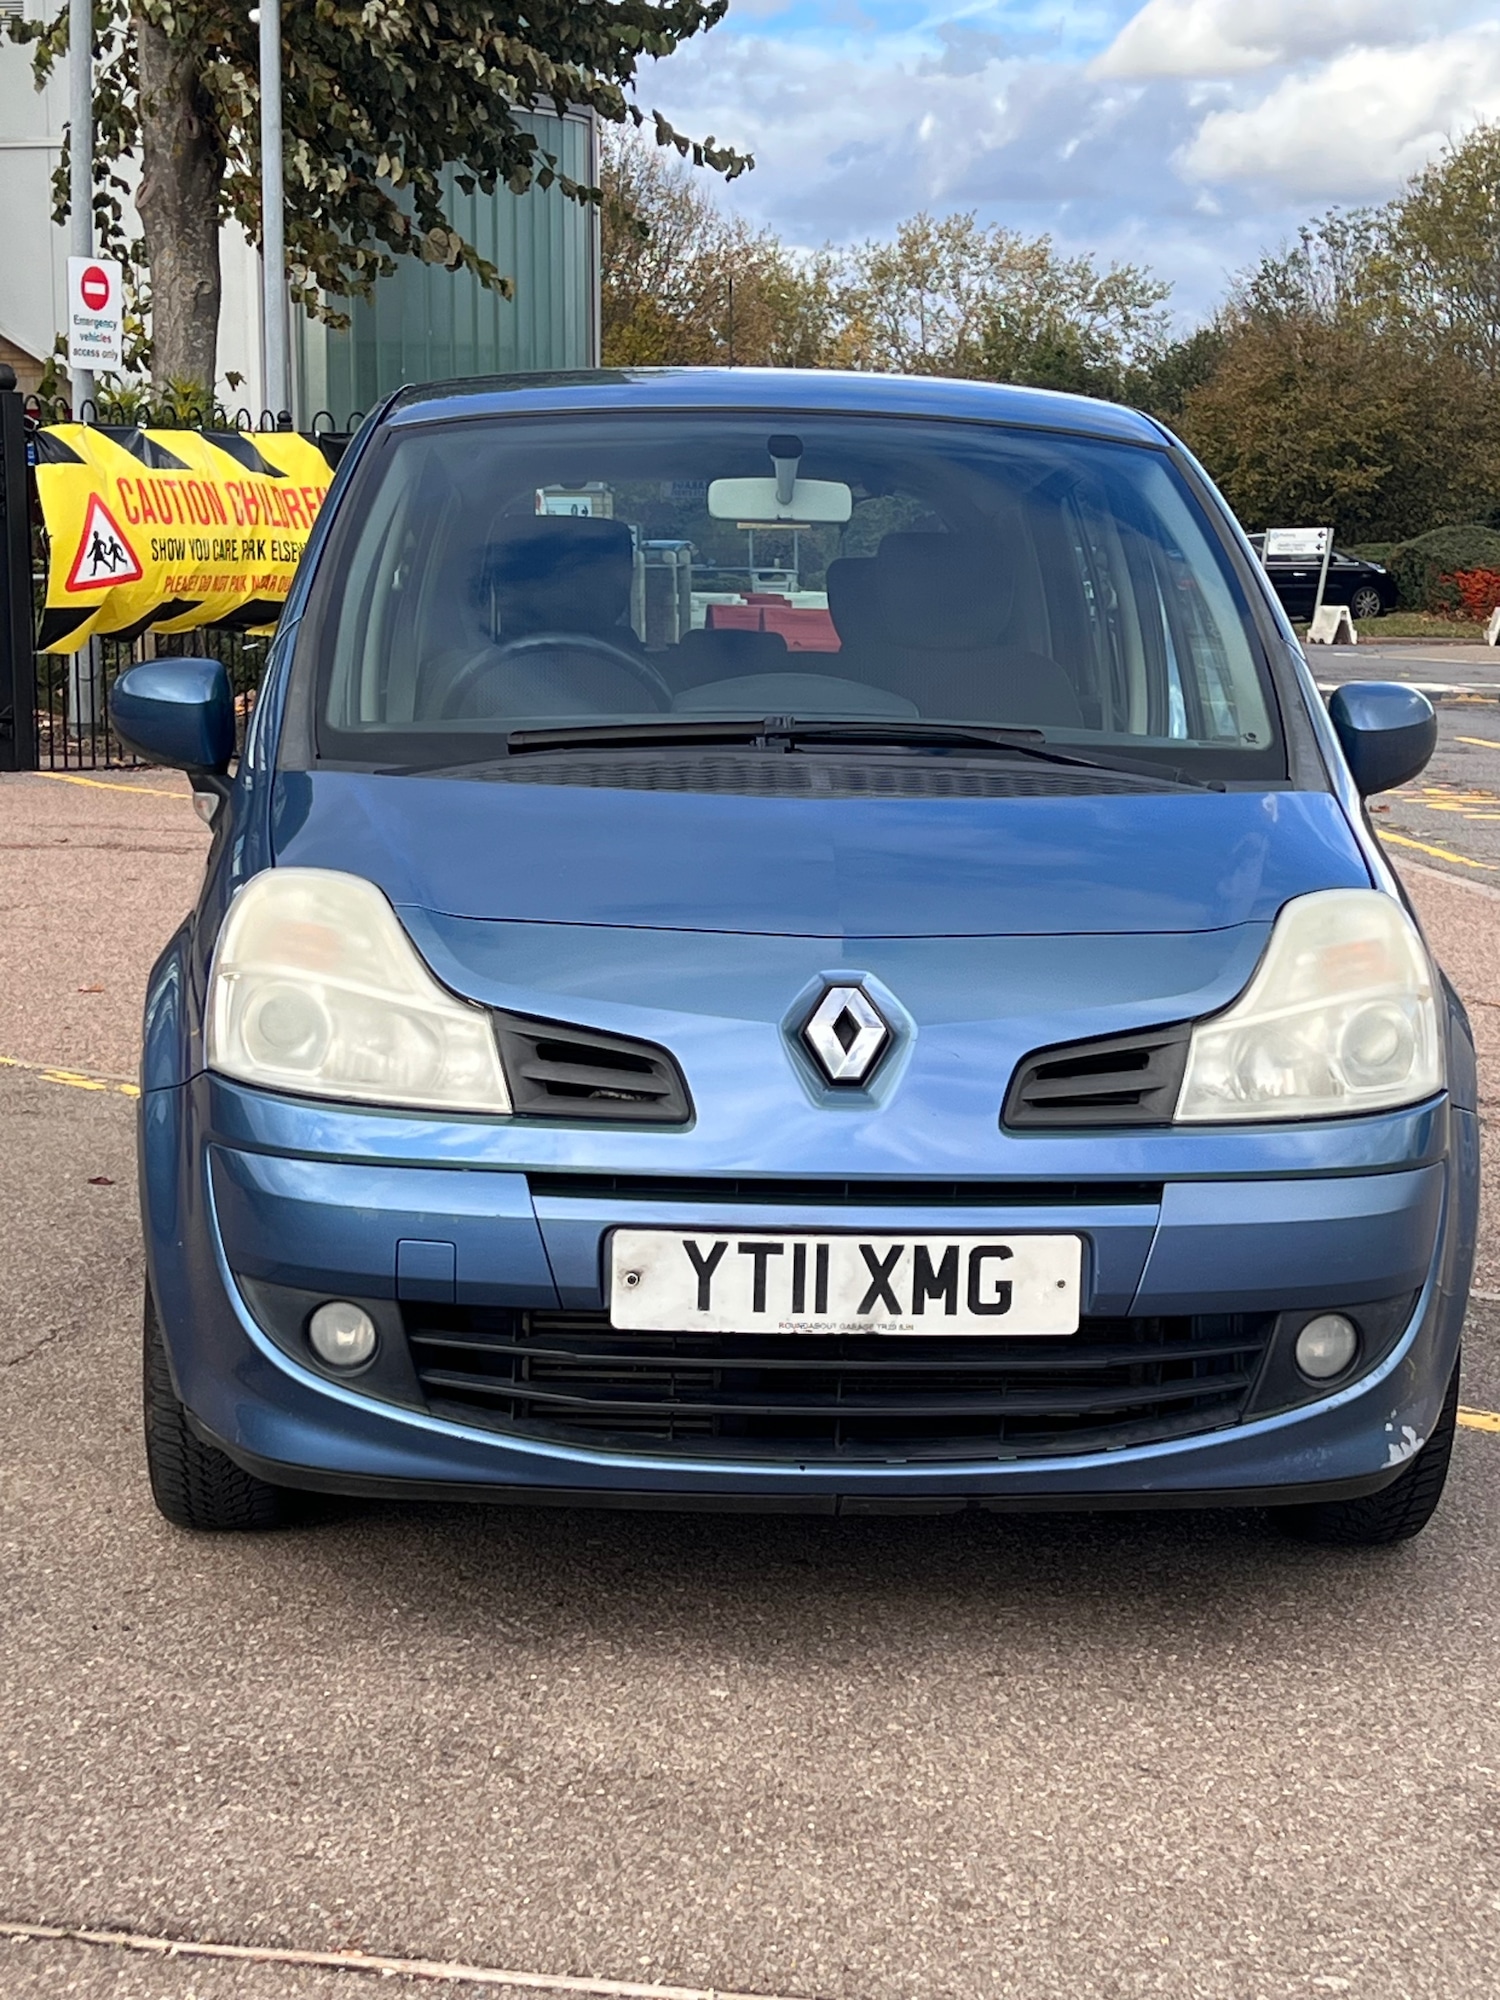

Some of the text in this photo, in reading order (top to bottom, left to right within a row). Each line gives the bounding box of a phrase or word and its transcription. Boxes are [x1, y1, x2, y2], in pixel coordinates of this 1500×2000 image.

[73, 314, 118, 331] Emergency
[79, 332, 112, 343] vehicles
[73, 348, 118, 362] access only
[116, 477, 228, 525] CAUTION
[151, 537, 186, 562] SHOW
[188, 537, 210, 561] YOU
[251, 574, 278, 593] NAR
[682, 1240, 1014, 1316] YT11 XMG
[778, 1322, 837, 1330] ROUNDABOUT
